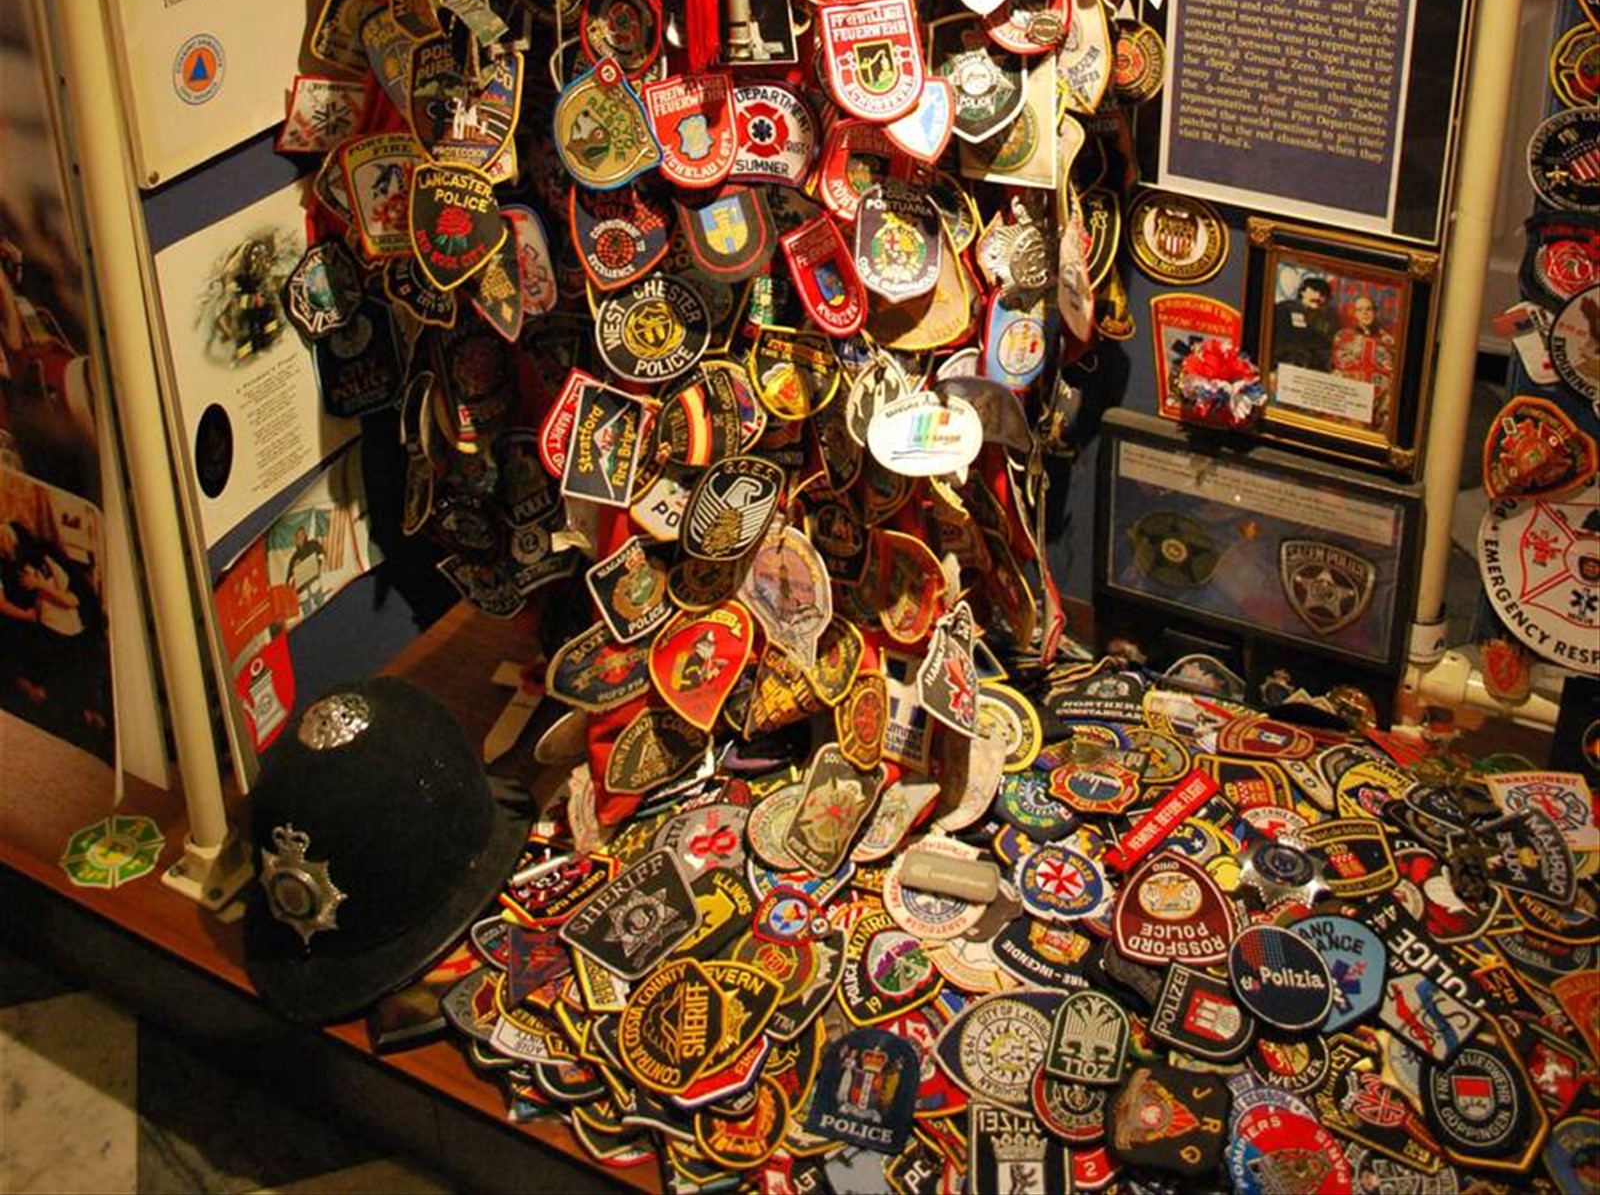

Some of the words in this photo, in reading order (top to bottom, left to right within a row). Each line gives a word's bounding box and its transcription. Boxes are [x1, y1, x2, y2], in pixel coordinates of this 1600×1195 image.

[735, 88, 813, 133] DEPARTMENT
[736, 160, 790, 175] SUMNER
[434, 189, 489, 214] POLICE
[632, 280, 702, 323] CHESTER
[603, 300, 628, 351] WEST
[634, 345, 695, 377] POLICE
[578, 405, 604, 474] Stratford
[1485, 540, 1551, 646] EMERGENCY
[570, 854, 665, 935] SHERIFF
[712, 872, 753, 916] ILLINOIS
[1127, 935, 1226, 957] ROSSFORD
[1140, 922, 1210, 939] POLICE
[637, 964, 687, 1005] COUNTY
[1259, 966, 1326, 990] Polizia
[682, 981, 710, 1058] SHERIFF
[1156, 968, 1190, 1037] POLIZEI
[624, 1007, 646, 1047] COSTA
[630, 1045, 681, 1086] CONTRA
[1063, 1057, 1109, 1079] ZOLL
[1267, 1058, 1324, 1088] WELVER
[818, 1113, 894, 1145] POLICE
